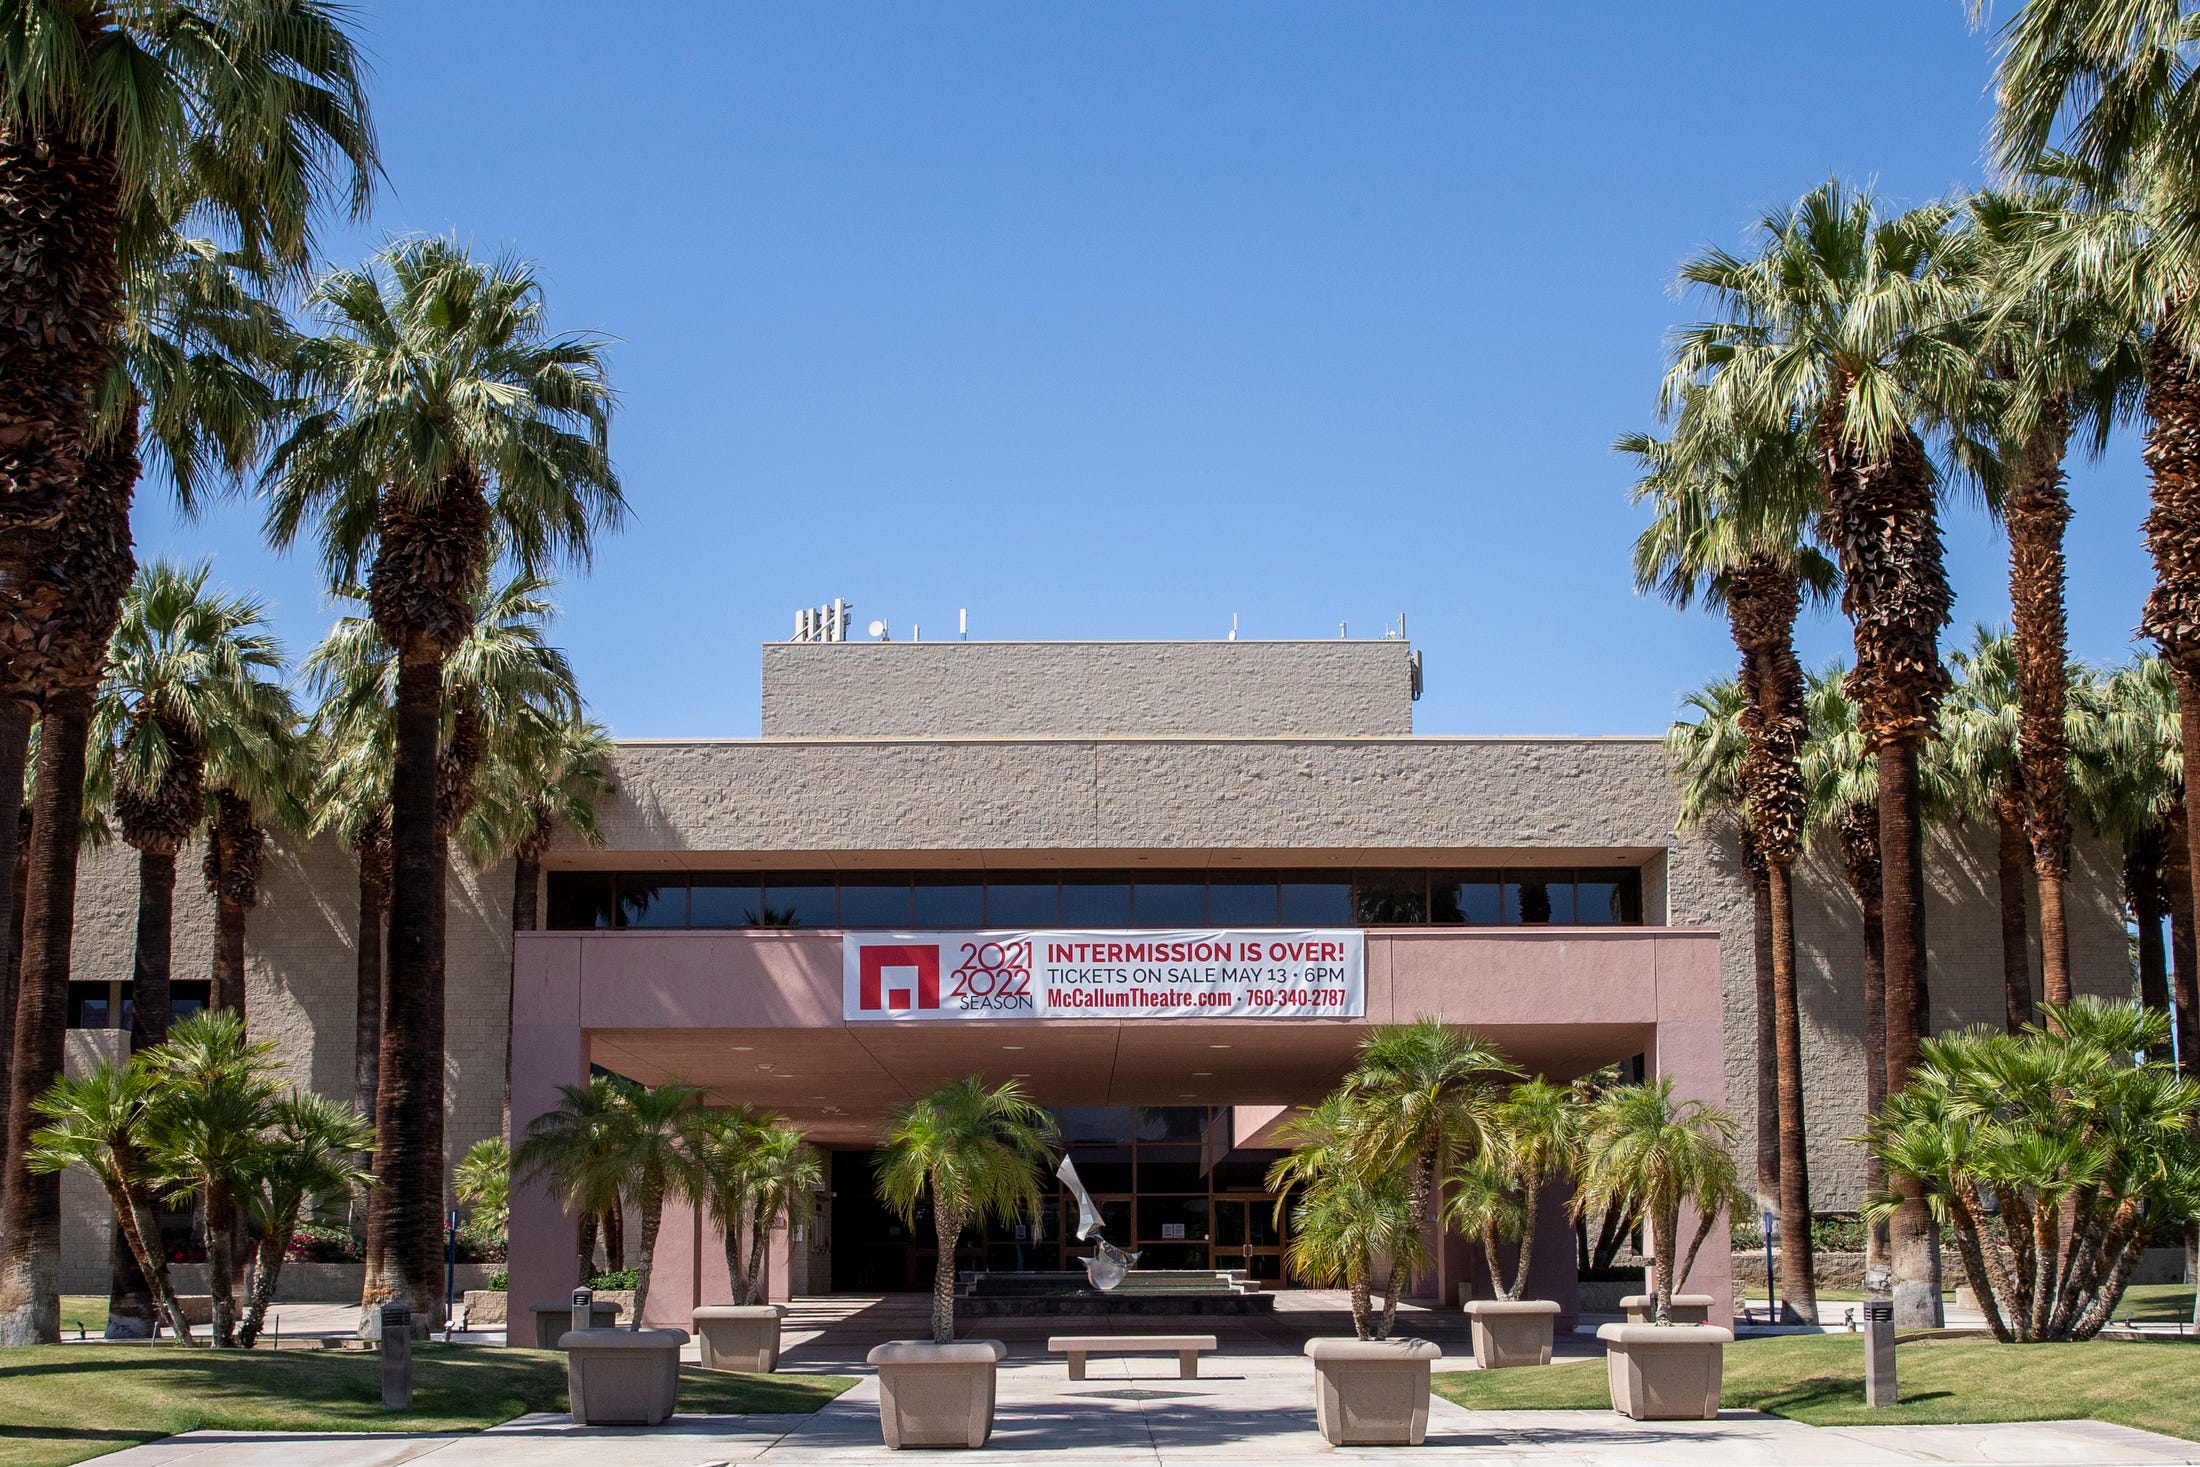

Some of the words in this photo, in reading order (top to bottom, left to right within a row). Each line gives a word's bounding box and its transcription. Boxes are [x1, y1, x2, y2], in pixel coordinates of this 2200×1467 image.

[960, 941, 1032, 970] 2021
[1047, 942, 1232, 963] INTERMISSION
[1239, 942, 1263, 962] IS
[1268, 942, 1345, 963] OVER!
[950, 968, 1031, 996] 2022
[1047, 967, 1128, 984] TICKETS
[1132, 967, 1162, 984] ON
[1167, 967, 1217, 984] SALE
[1221, 967, 1263, 983] MAY
[1267, 968, 1287, 984] 13
[1304, 967, 1345, 983] 6PM
[960, 995, 1033, 1010] SEASON
[1047, 988, 1232, 1008] McCallumTheatre.com
[1245, 988, 1346, 1008] 760-340-2787
